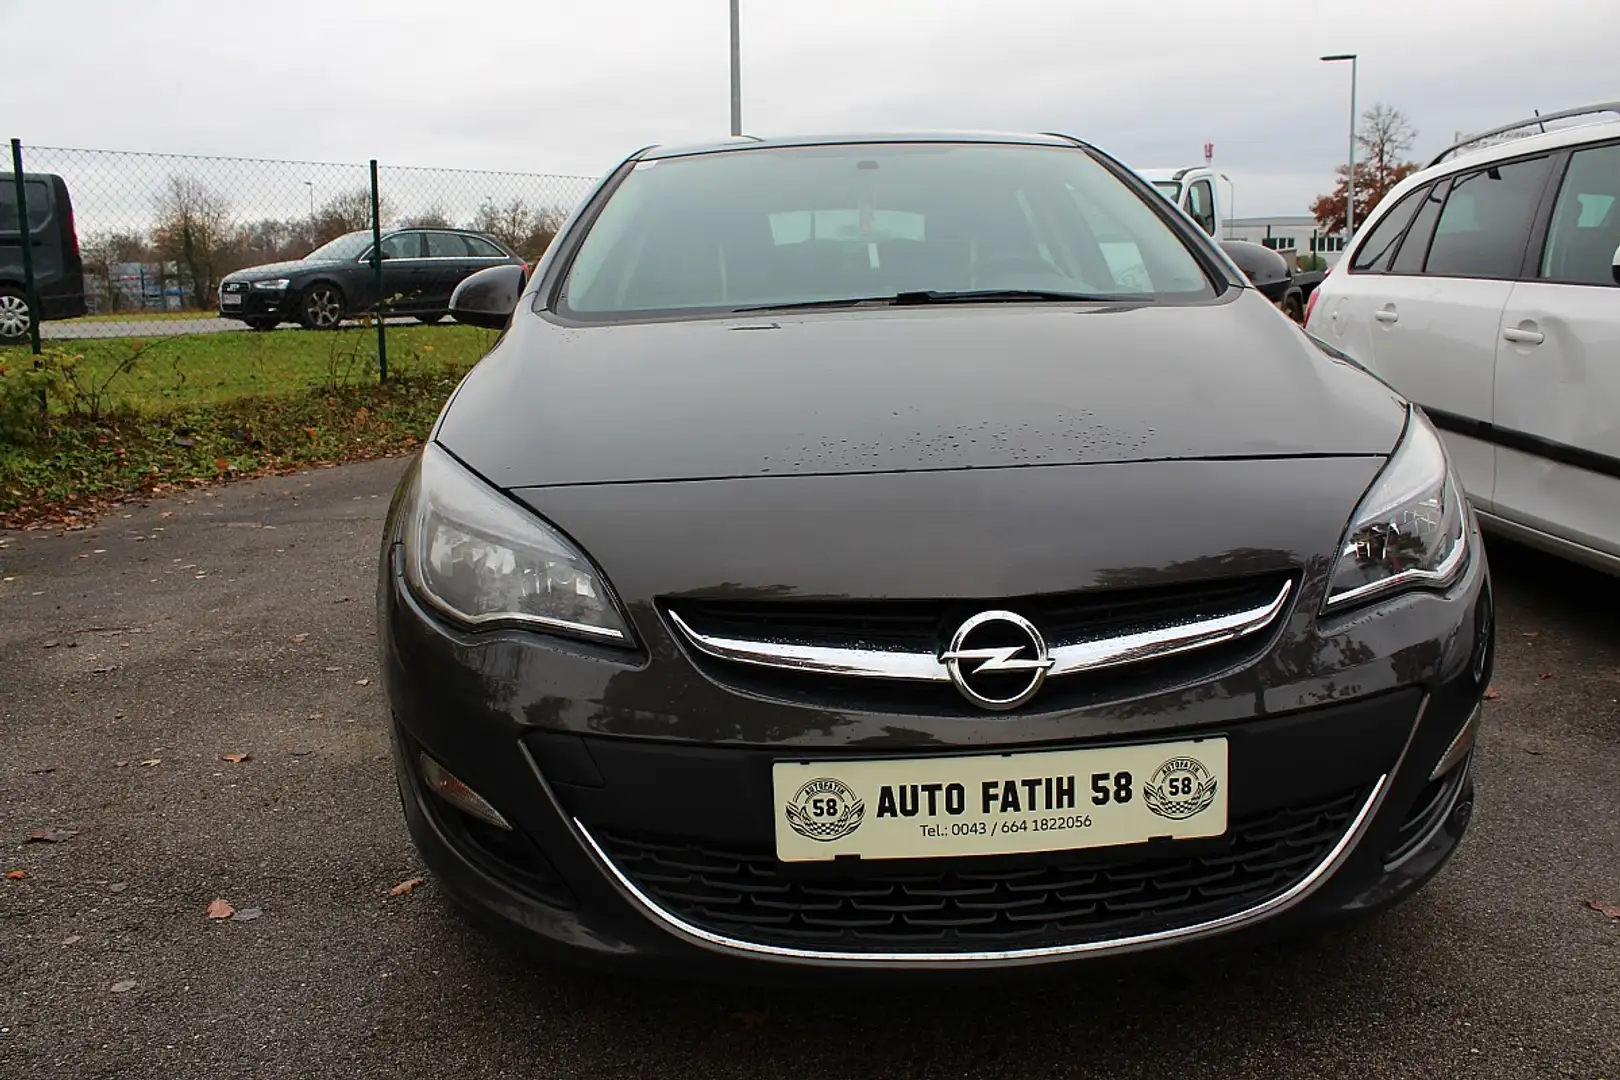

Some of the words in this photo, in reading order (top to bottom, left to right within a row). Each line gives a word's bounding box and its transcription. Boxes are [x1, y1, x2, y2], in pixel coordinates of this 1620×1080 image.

[877, 783, 965, 818] AUTO
[982, 775, 1075, 813] FATIH
[1091, 771, 1133, 805] 58
[1169, 777, 1192, 796] 58
[813, 798, 838, 817] 58
[920, 824, 948, 837] Tel.:
[951, 822, 987, 836] 0043
[990, 821, 998, 837] /
[1001, 820, 1028, 833] 664
[1032, 815, 1092, 831] 1822056
